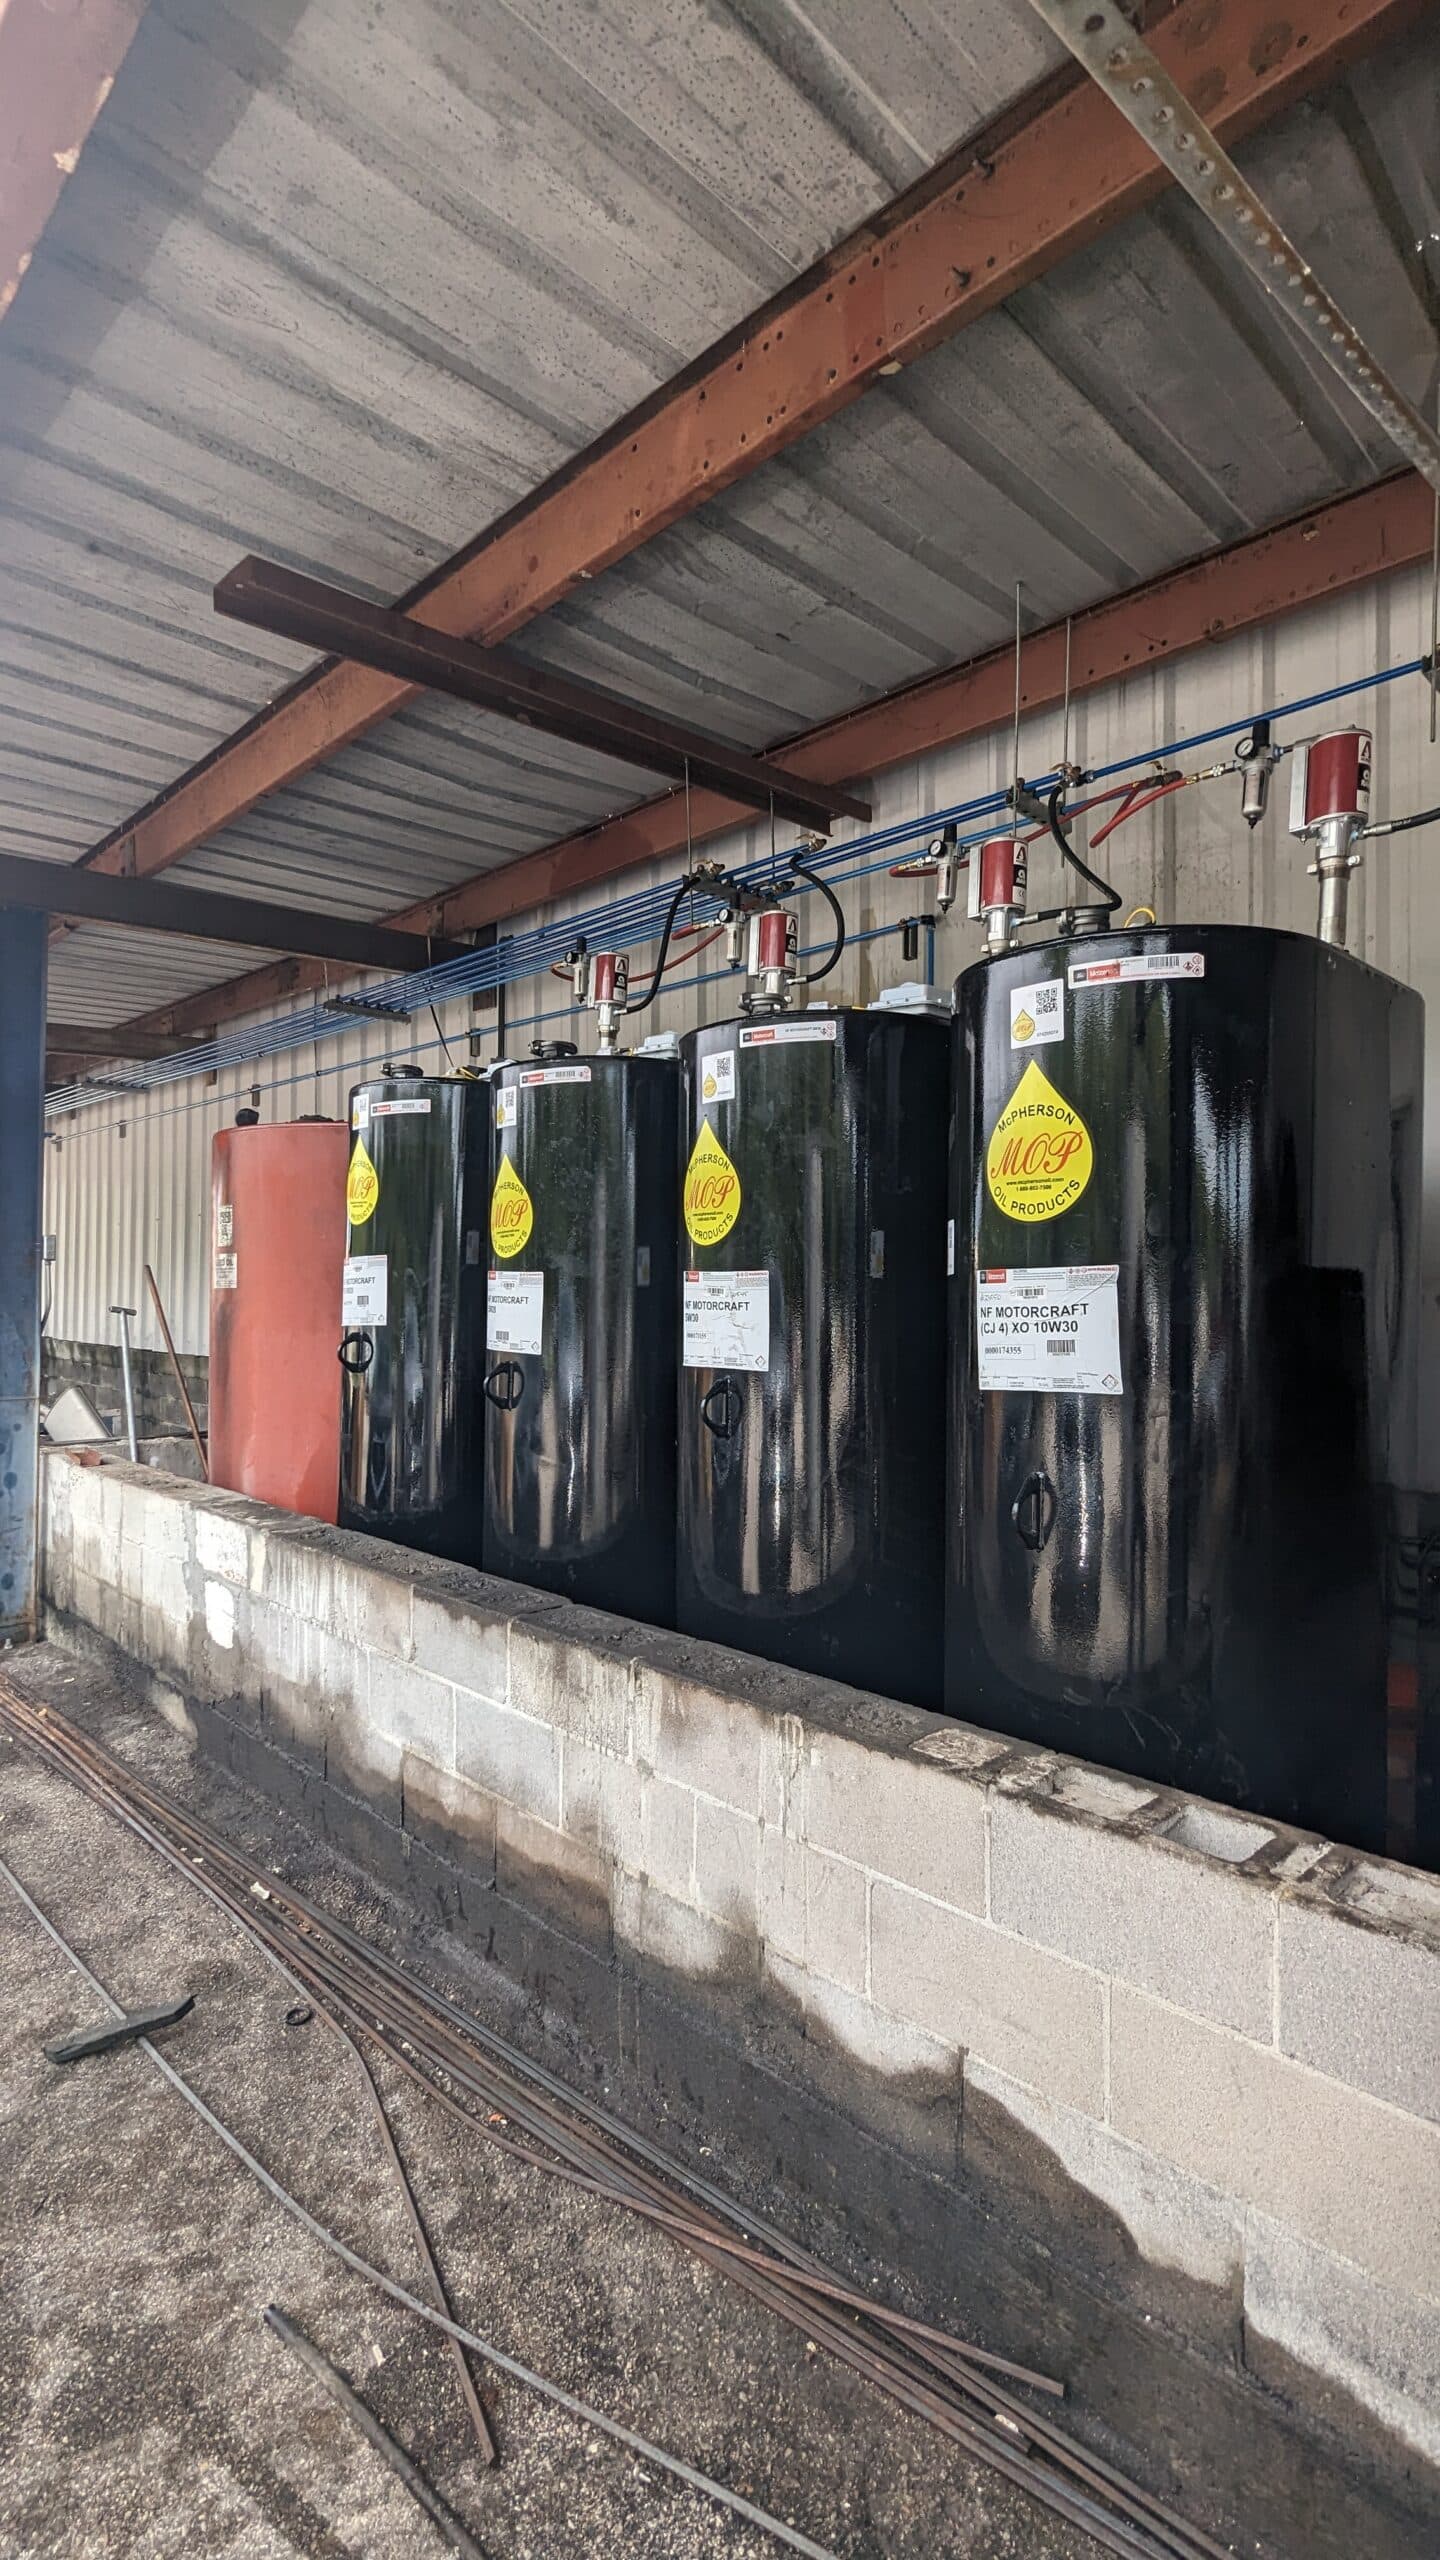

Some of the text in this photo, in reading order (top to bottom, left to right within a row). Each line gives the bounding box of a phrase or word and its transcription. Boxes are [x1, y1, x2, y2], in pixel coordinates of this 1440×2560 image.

[998, 1104, 1076, 1133] McPHERSON
[990, 1131, 1084, 1179] MOP
[686, 1175, 735, 1211] MOP
[994, 1179, 1080, 1215] OIL PRODUCTS
[694, 1212, 734, 1240] PRODUCTS
[692, 1300, 750, 1312] MOTORCRAFT
[980, 1303, 1089, 1318] NF MOTORCRAFT
[980, 1320, 1079, 1336] (CJ 4) XO 10W30
